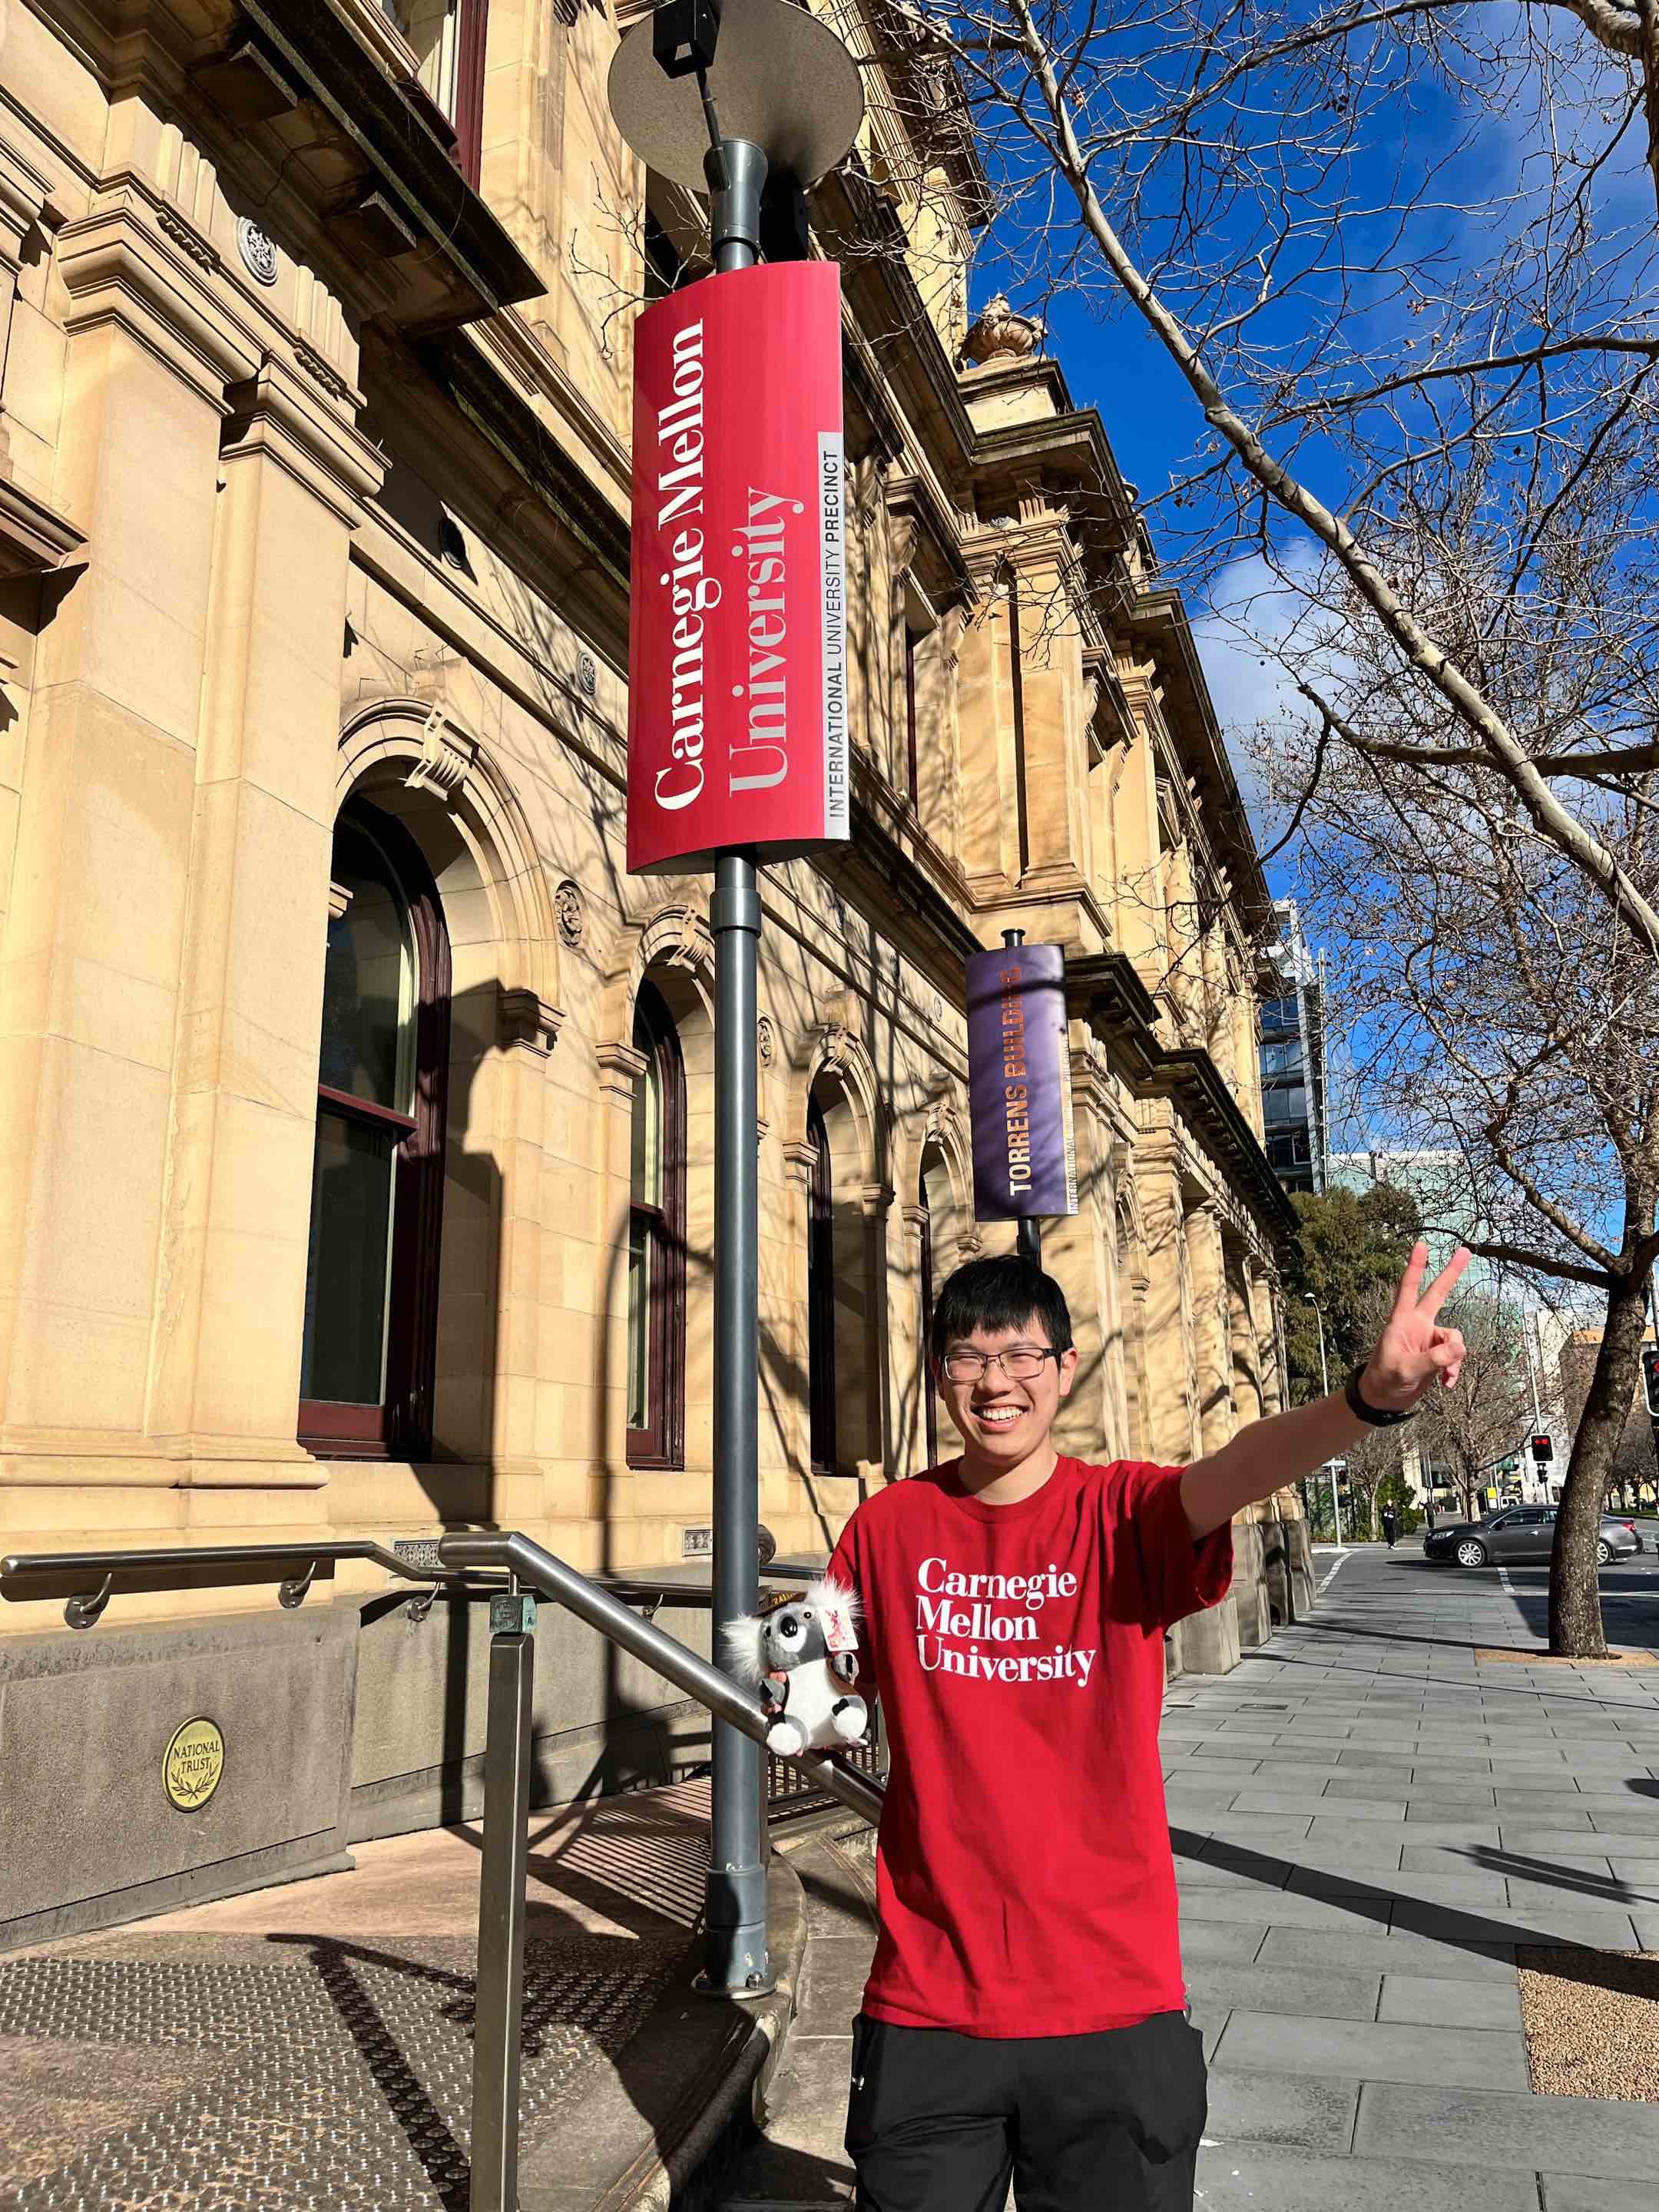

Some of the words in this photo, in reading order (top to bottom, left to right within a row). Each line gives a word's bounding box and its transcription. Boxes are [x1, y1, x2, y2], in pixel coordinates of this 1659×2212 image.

[657, 318, 704, 531] Mellon
[823, 450, 839, 542] PRECINCT
[729, 487, 805, 798] University
[825, 549, 842, 654] UNIVERSITY
[654, 528, 721, 810] Carnegie
[827, 661, 844, 818] INTERNATIONAL
[1005, 1085, 1032, 1197] TORRENS
[916, 1594, 1039, 1641] Mellon
[918, 1558, 1077, 1610] Carnegie
[916, 1634, 1097, 1687] University
[174, 1740, 220, 1759] NATIONAL
[181, 1757, 210, 1773] TRUST
